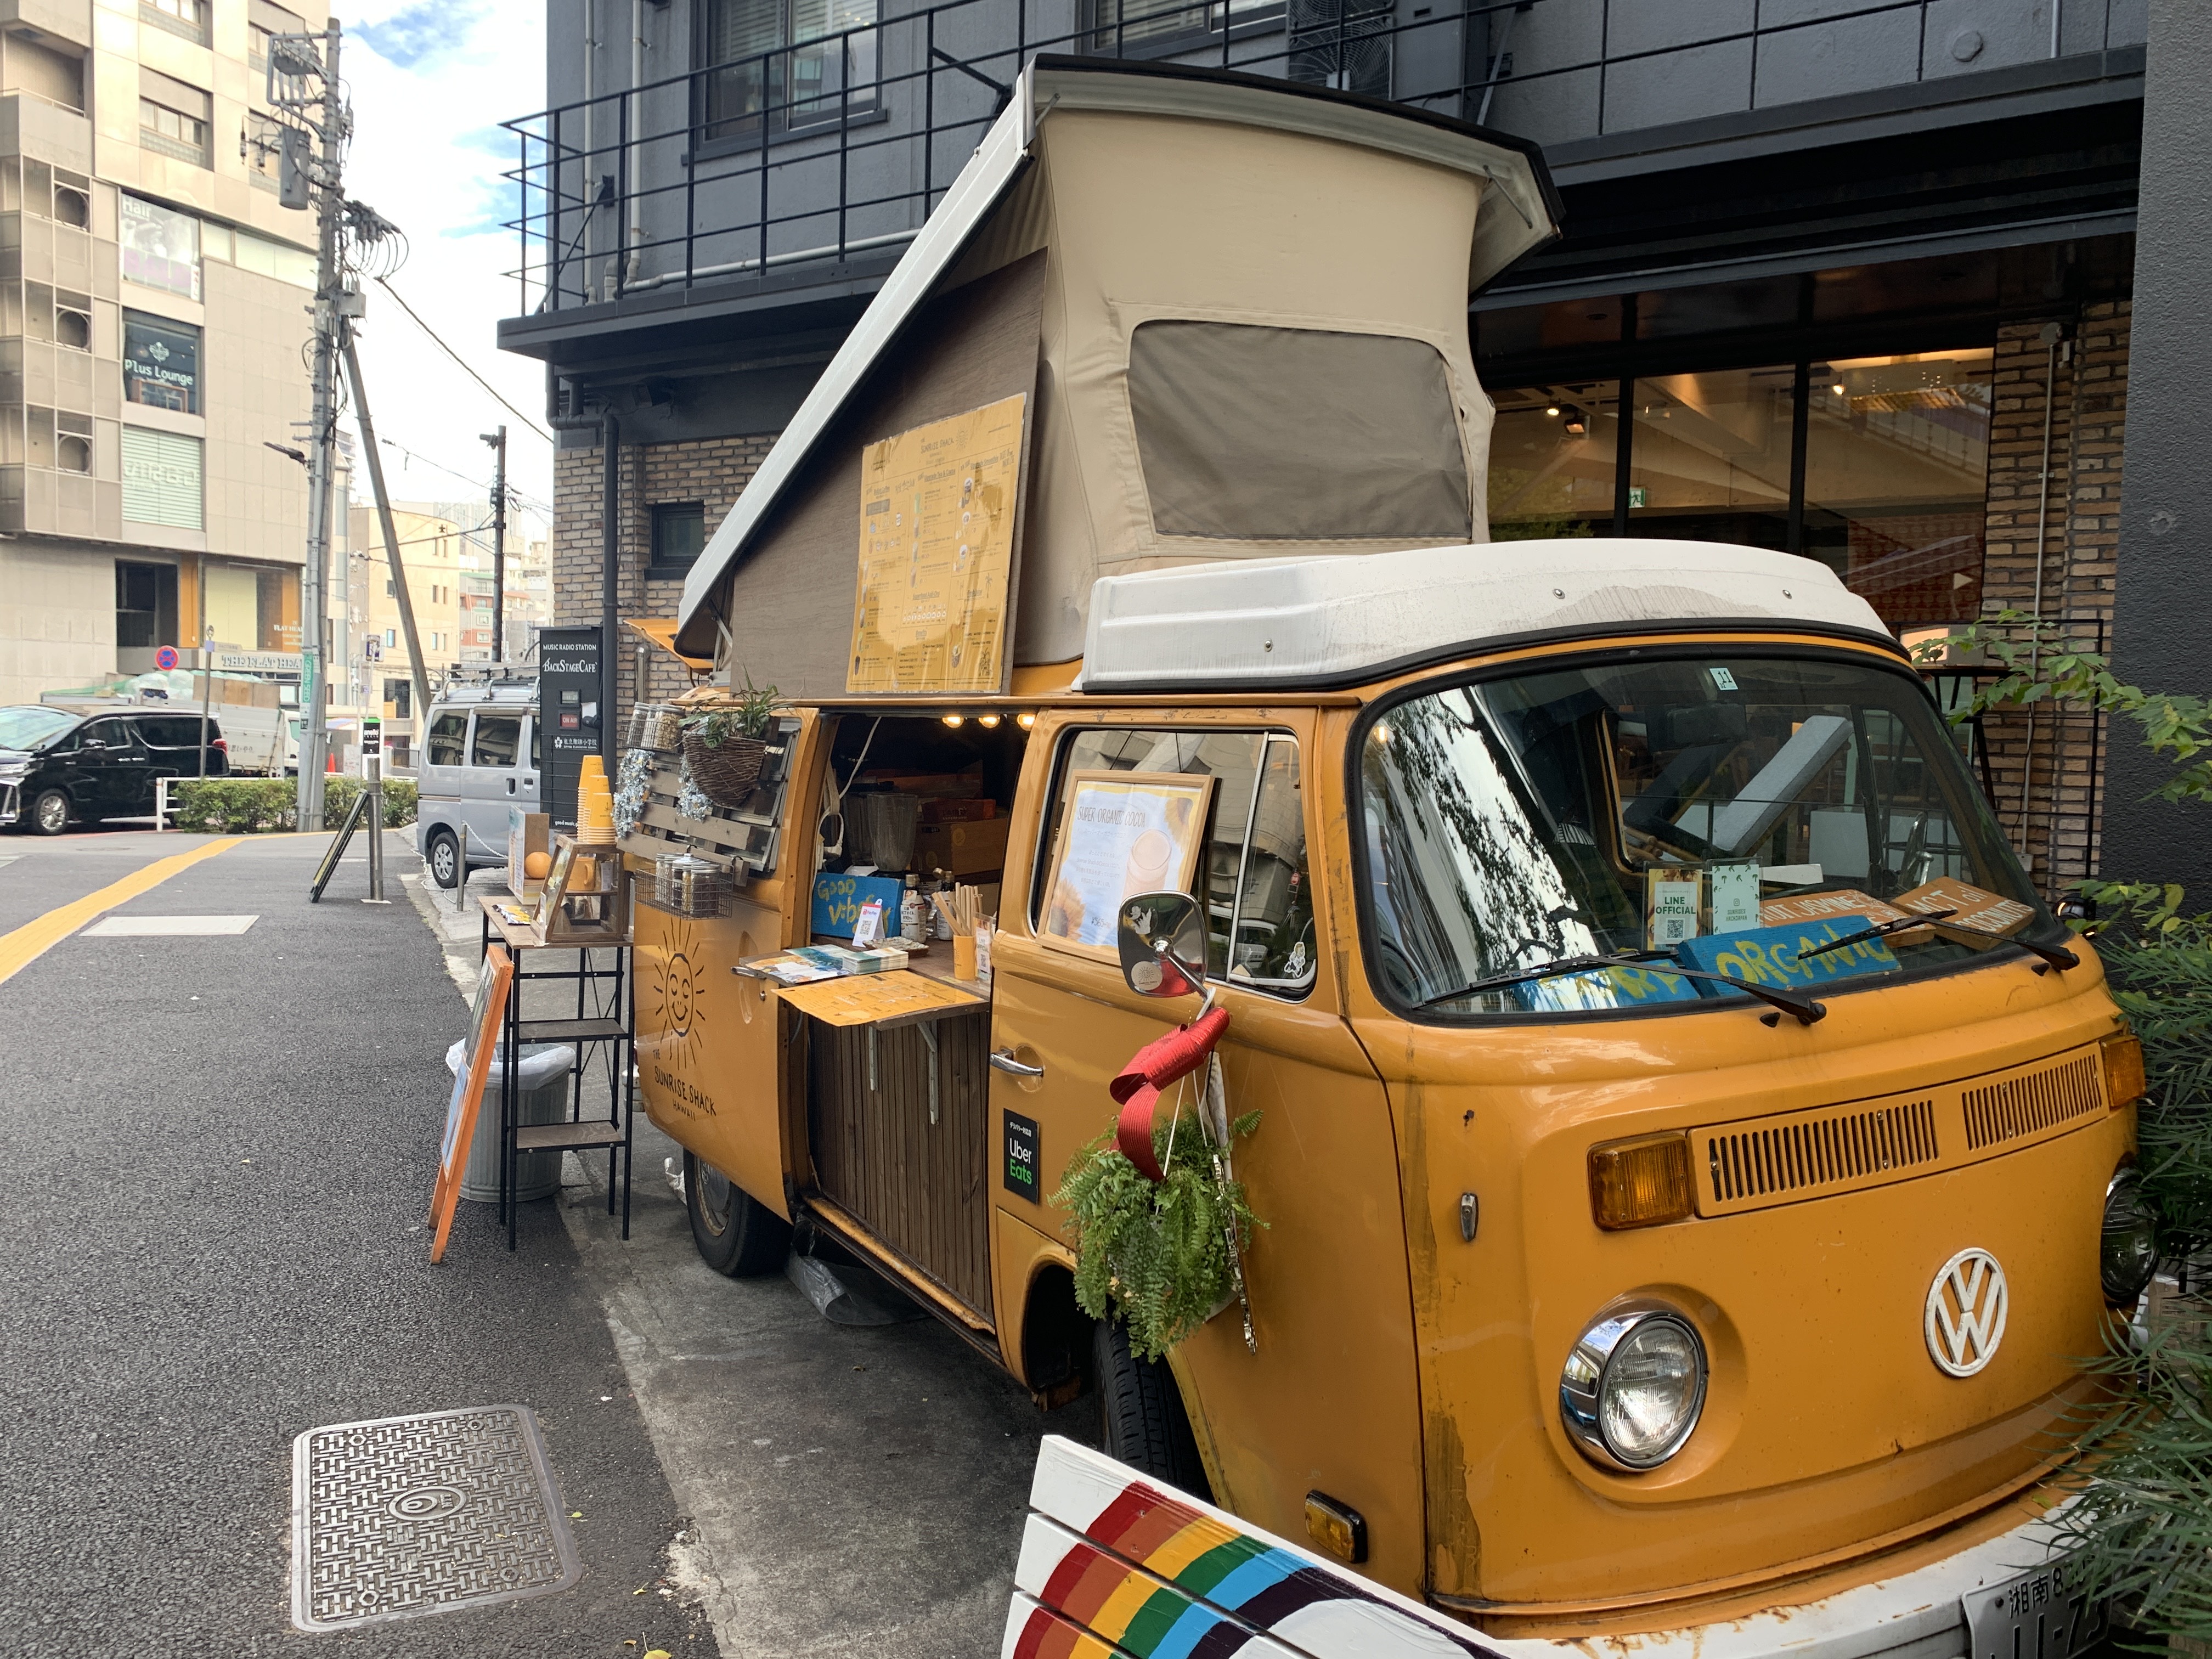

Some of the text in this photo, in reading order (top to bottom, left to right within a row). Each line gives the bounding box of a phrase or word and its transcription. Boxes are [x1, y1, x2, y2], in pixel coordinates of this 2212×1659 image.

[122, 196, 151, 217] Hair
[125, 359, 193, 386] Plus Lounge
[222, 655, 302, 669] THE FLAT HEA
[1077, 806, 1146, 828] SUPER ORGANIC COCOA
[1656, 906, 1696, 915] OFFICIAL
[1664, 896, 1685, 905] LINE
[1759, 896, 1866, 922] RUIT JASMINE
[1905, 885, 1988, 913] MCT oil
[1716, 924, 1894, 985] ORGANIC
[654, 1065, 716, 1116] SUNRISE SHACK
[673, 1098, 696, 1122] HAWAII
[1009, 1137, 1032, 1164] Uber
[1009, 1158, 1032, 1185] Eats
[2008, 1573, 2049, 1619] 湘南
